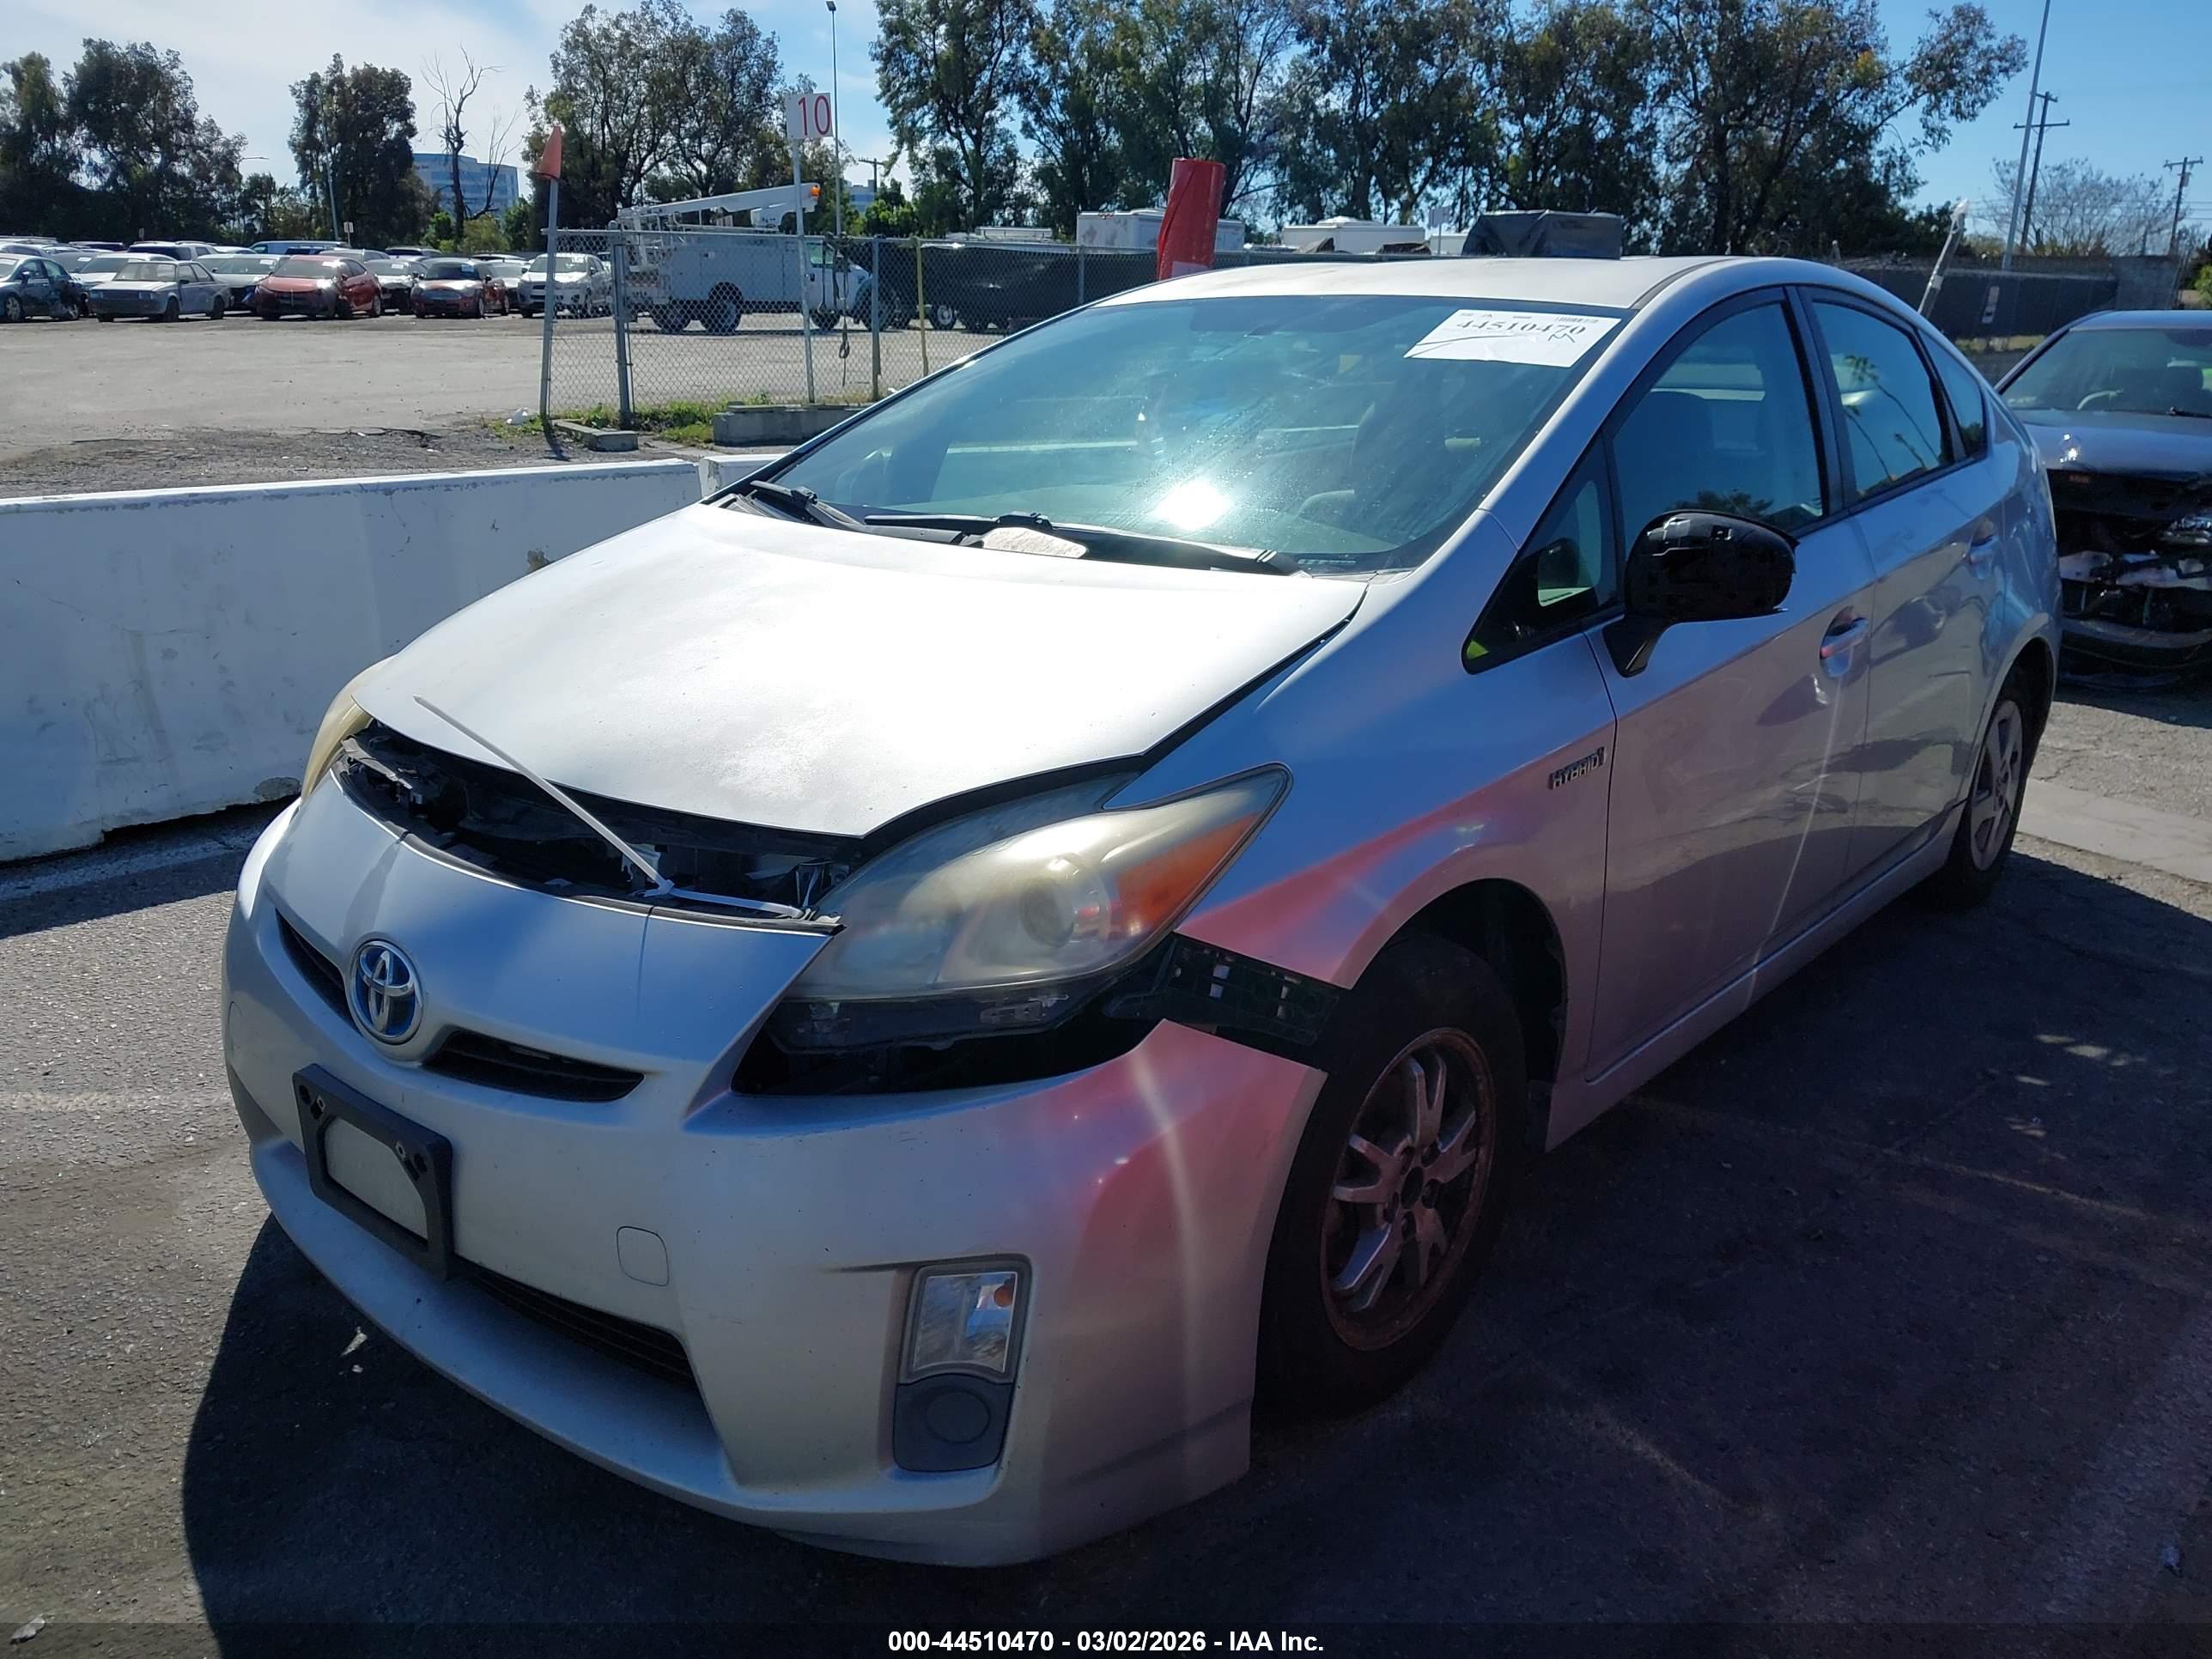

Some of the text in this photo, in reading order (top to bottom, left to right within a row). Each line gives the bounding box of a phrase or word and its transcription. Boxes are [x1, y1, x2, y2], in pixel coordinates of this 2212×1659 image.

[798, 95, 830, 136] 10
[1456, 319, 1587, 334] 44510470
[1552, 752, 1600, 789] HYBRID
